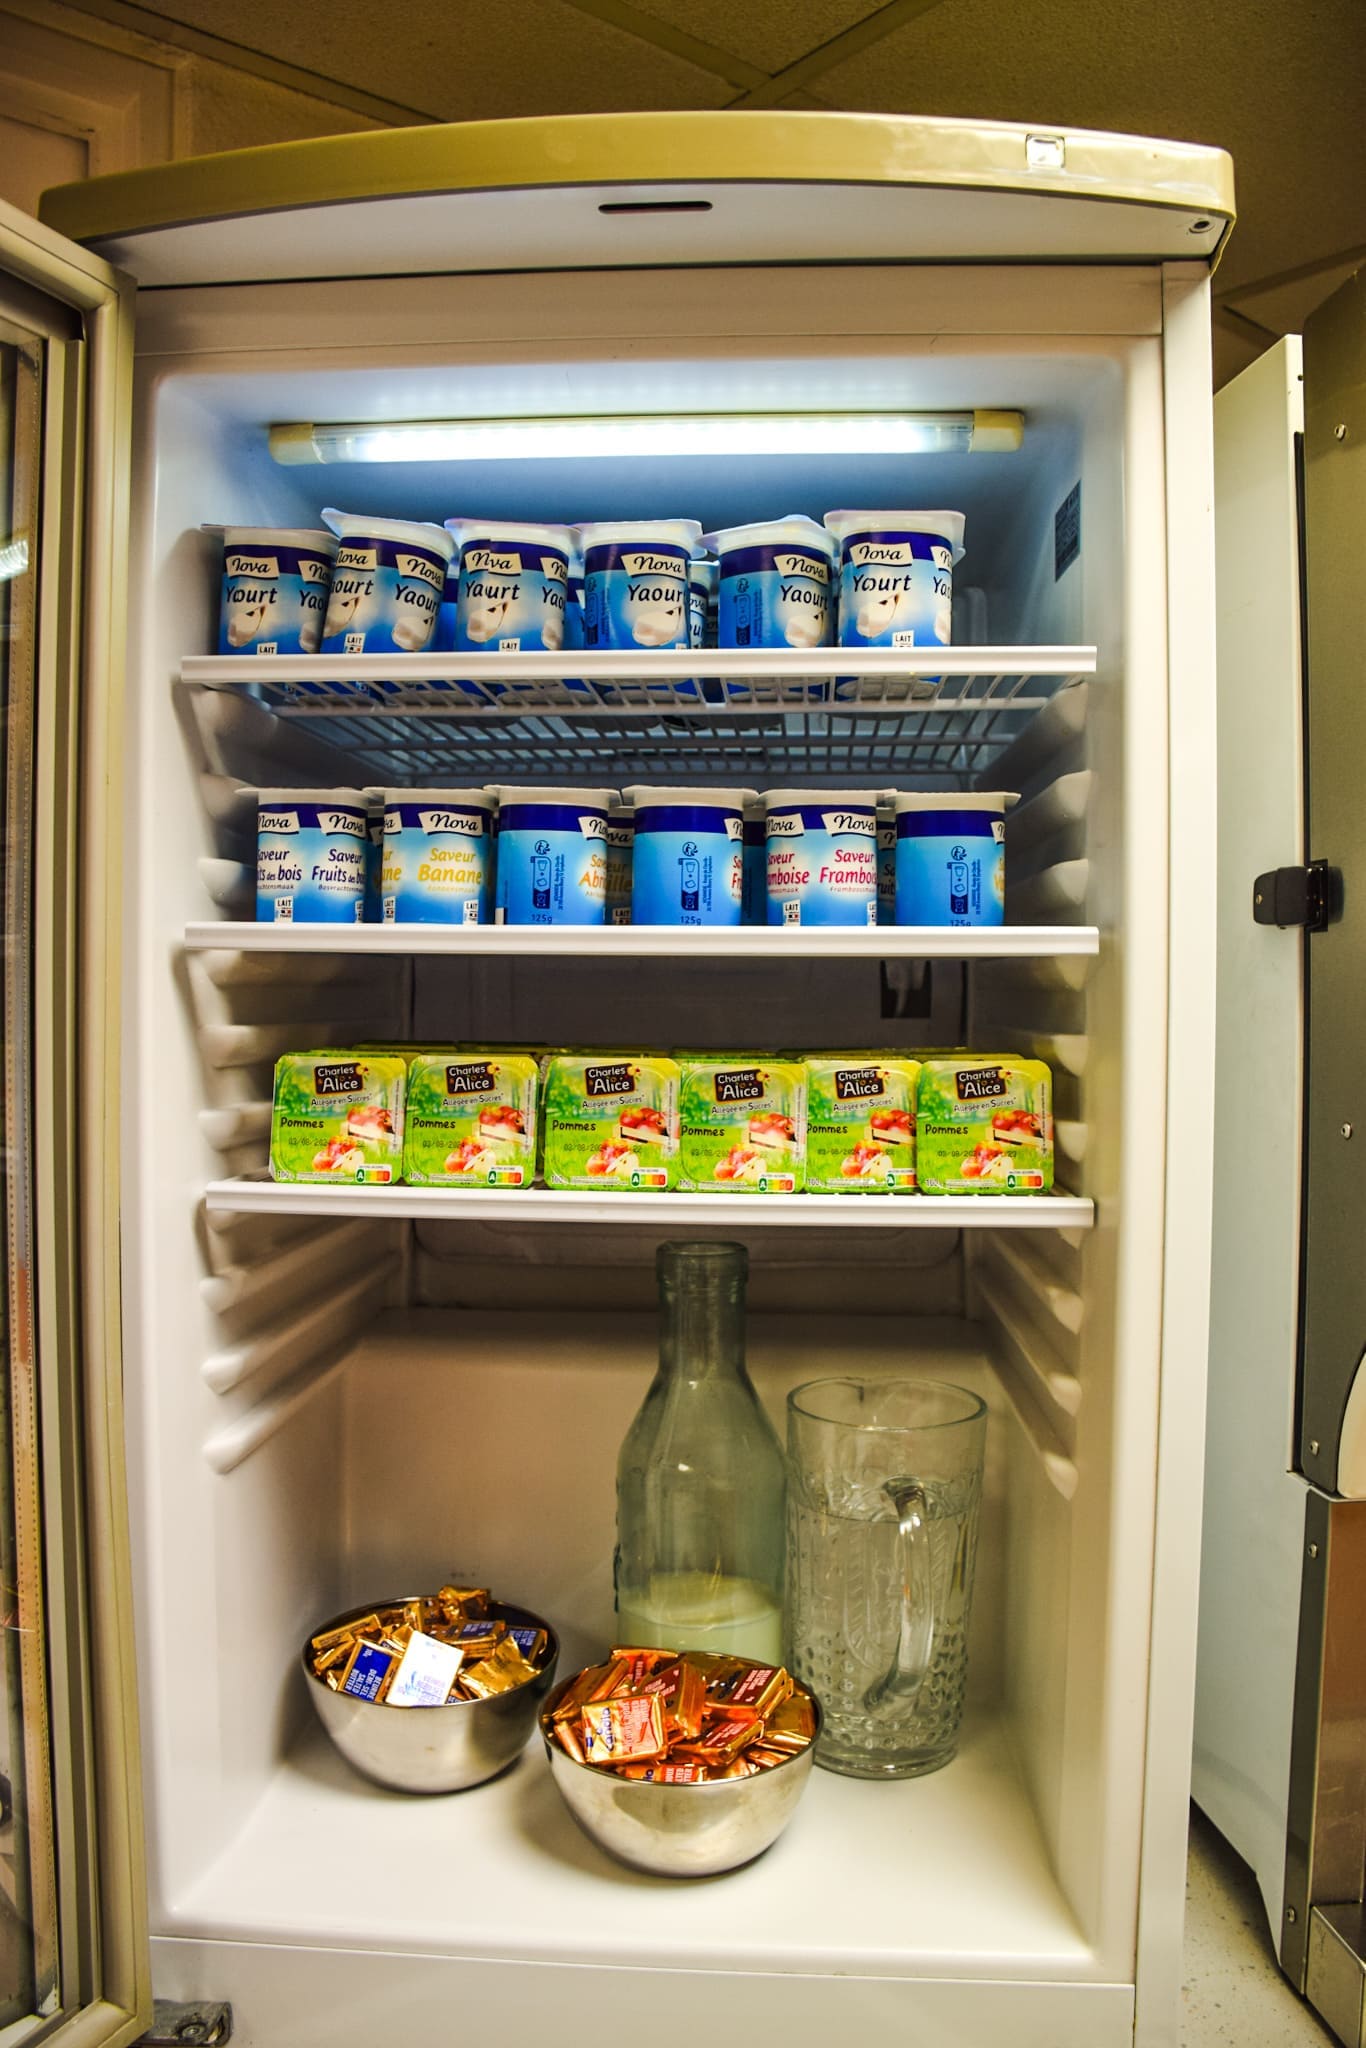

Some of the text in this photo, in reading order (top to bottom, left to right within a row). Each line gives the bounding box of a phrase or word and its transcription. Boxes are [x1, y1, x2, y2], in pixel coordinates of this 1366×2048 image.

[634, 556, 682, 573] Nova
[786, 557, 825, 578] Nova
[628, 584, 683, 602] Yaour
[347, 636, 362, 644] LAIT
[502, 642, 517, 650] LAIT
[329, 815, 364, 832] Nova
[430, 813, 479, 831] Nova
[834, 814, 875, 831] Nova
[259, 849, 290, 860] aveur
[430, 848, 476, 862] Saveur
[834, 849, 875, 863] Saveur
[267, 871, 276, 880] des
[278, 864, 302, 881] bois
[312, 866, 347, 883] Fruits
[417, 864, 482, 884] Banane
[531, 914, 552, 924] 125g
[680, 916, 702, 926] 125g
[318, 1066, 354, 1077] Charles
[449, 1065, 486, 1076] Charles
[588, 1067, 626, 1078] Charles
[838, 1070, 875, 1082] Charles
[959, 1070, 996, 1082] Charles
[322, 1077, 358, 1092] Alice
[454, 1077, 490, 1092] Alice
[717, 1073, 755, 1084] Charles
[593, 1078, 630, 1094] Alice
[722, 1085, 759, 1100] Alice
[843, 1082, 879, 1097] Alice
[964, 1083, 1001, 1098] Alice
[280, 1117, 324, 1128] Pommes
[412, 1117, 456, 1128] Pommes
[552, 1119, 596, 1131] Pommes
[807, 1123, 848, 1134] Pommes
[925, 1124, 968, 1135] Pommes
[681, 1125, 725, 1136] Pommes
[345, 1668, 360, 1691] BUTTER
[352, 1672, 366, 1694] SALTED
[360, 1669, 377, 1696] DEMI-SEL
